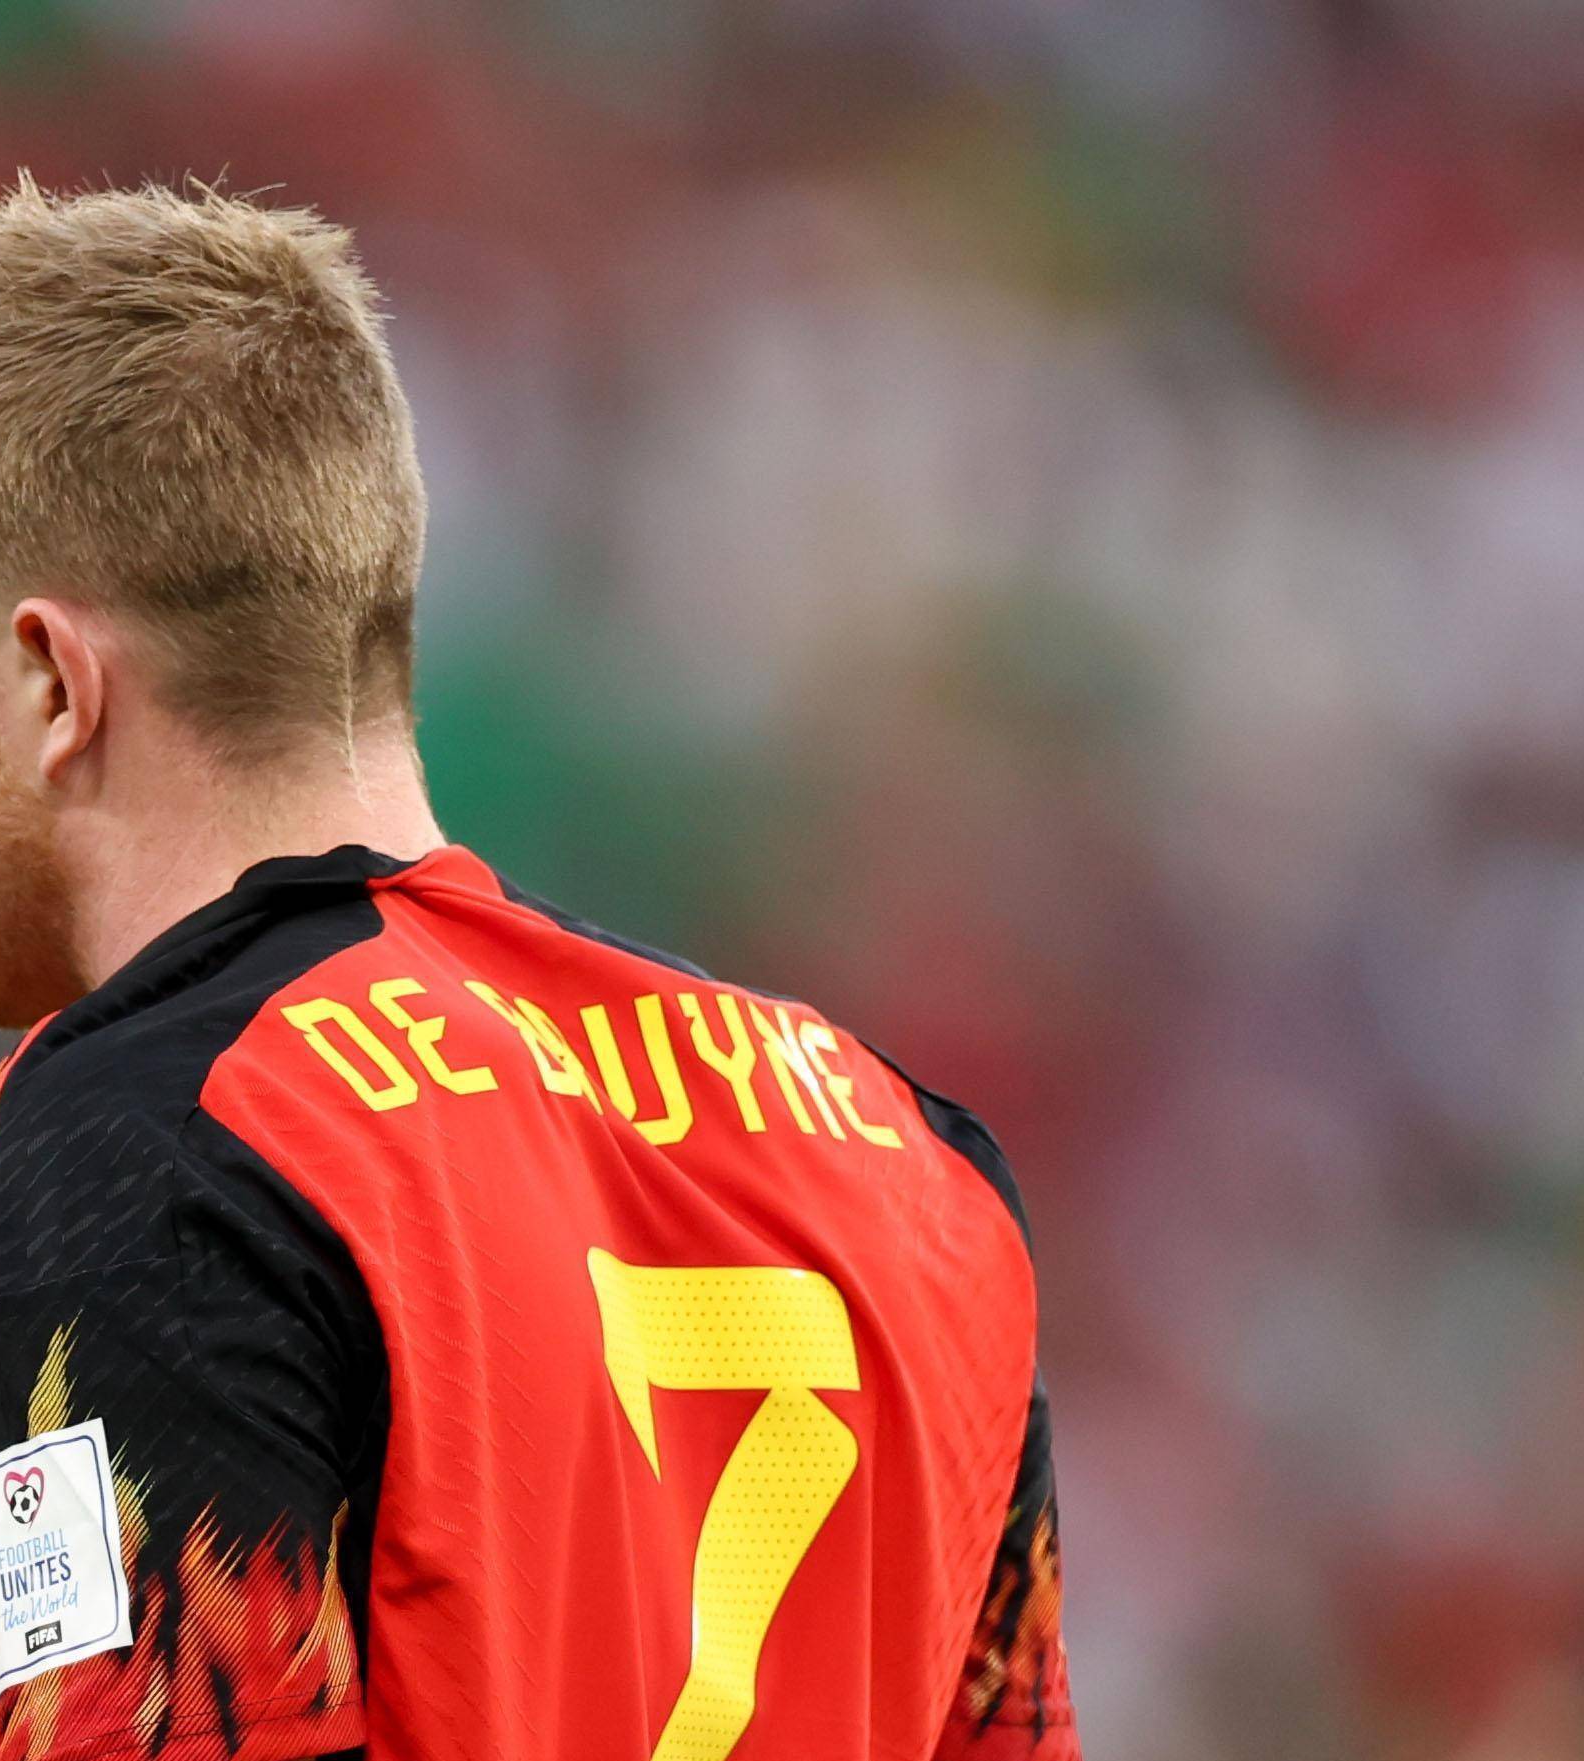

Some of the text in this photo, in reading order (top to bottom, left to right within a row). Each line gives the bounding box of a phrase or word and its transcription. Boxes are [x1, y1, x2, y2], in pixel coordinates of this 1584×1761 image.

[280, 977, 498, 1112] DE
[0, 1552, 72, 1601] UNITES
[0, 1582, 79, 1632] the World
[28, 1627, 59, 1650] FIFA
